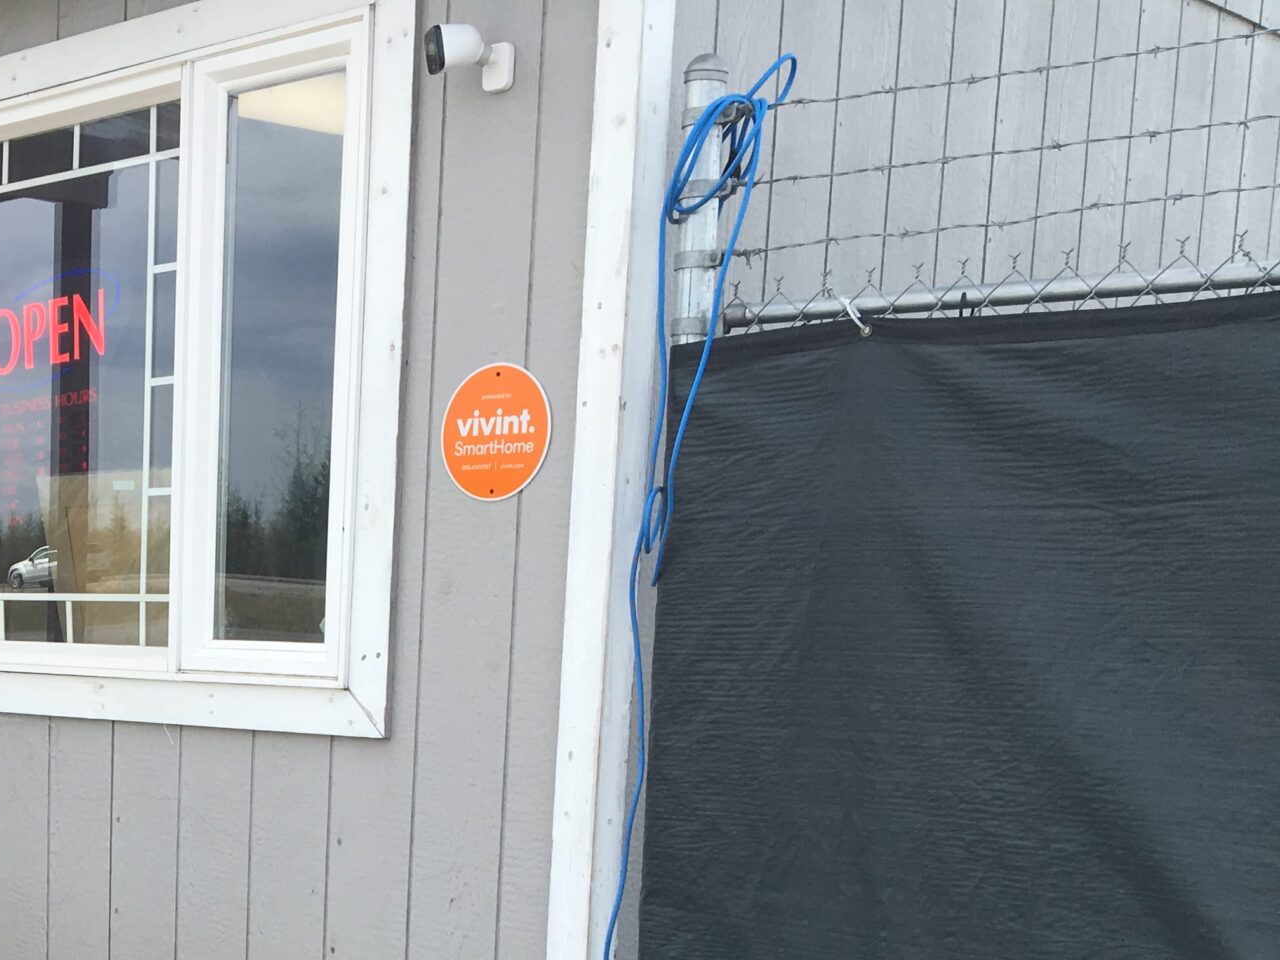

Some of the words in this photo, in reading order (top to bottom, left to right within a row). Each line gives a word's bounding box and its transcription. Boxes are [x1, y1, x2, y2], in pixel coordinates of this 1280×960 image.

[54, 388, 98, 408] HOURS
[456, 408, 535, 438] vivint.
[454, 439, 534, 457] SmartHome
